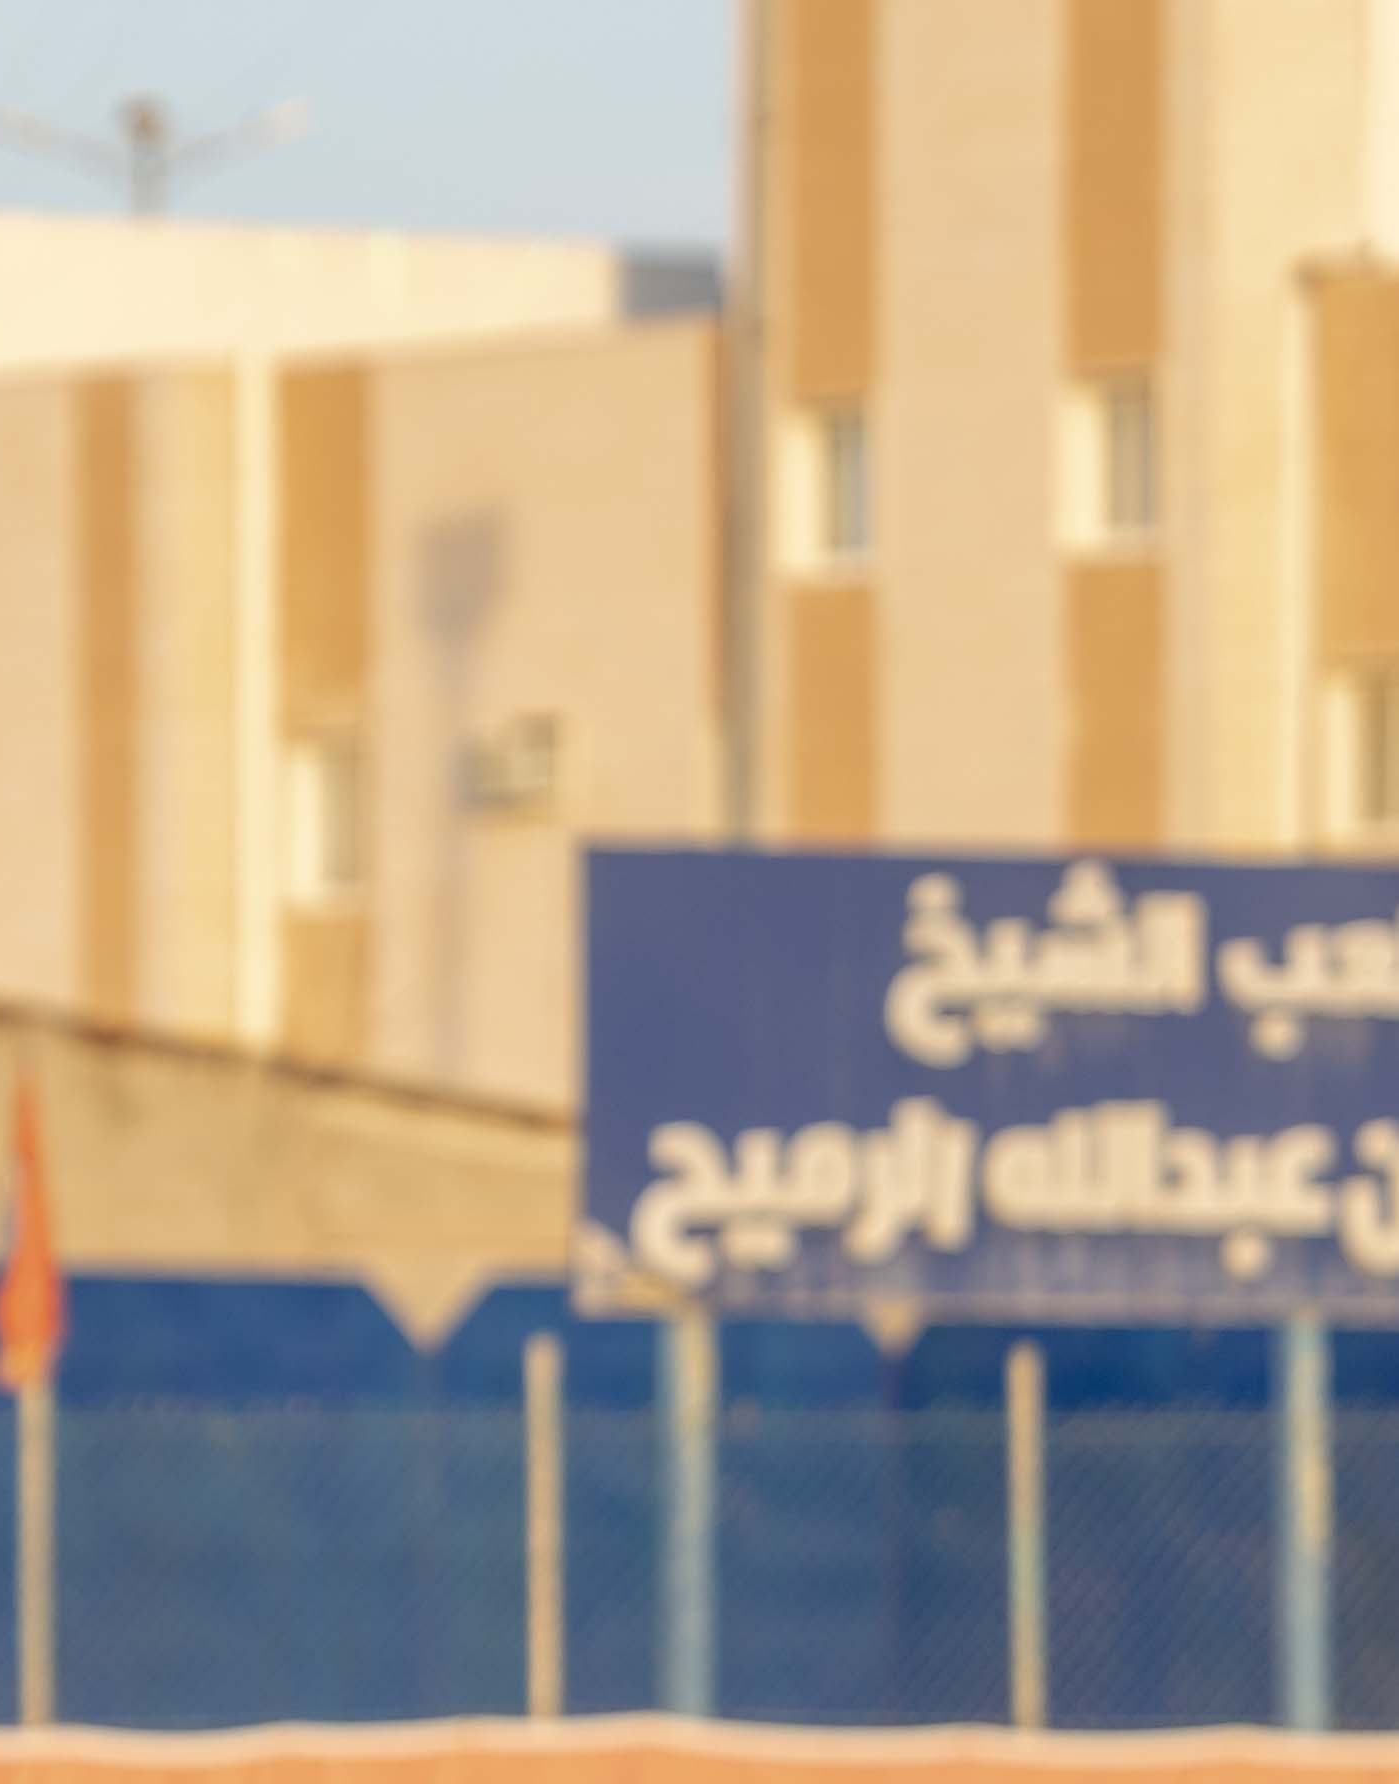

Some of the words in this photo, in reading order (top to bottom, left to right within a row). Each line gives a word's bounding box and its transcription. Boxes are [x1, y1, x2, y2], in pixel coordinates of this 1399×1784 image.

[885, 860, 1205, 1069] الشيخ
[1215, 900, 1399, 1062] عب
[984, 1099, 1339, 1280] عبدالله
